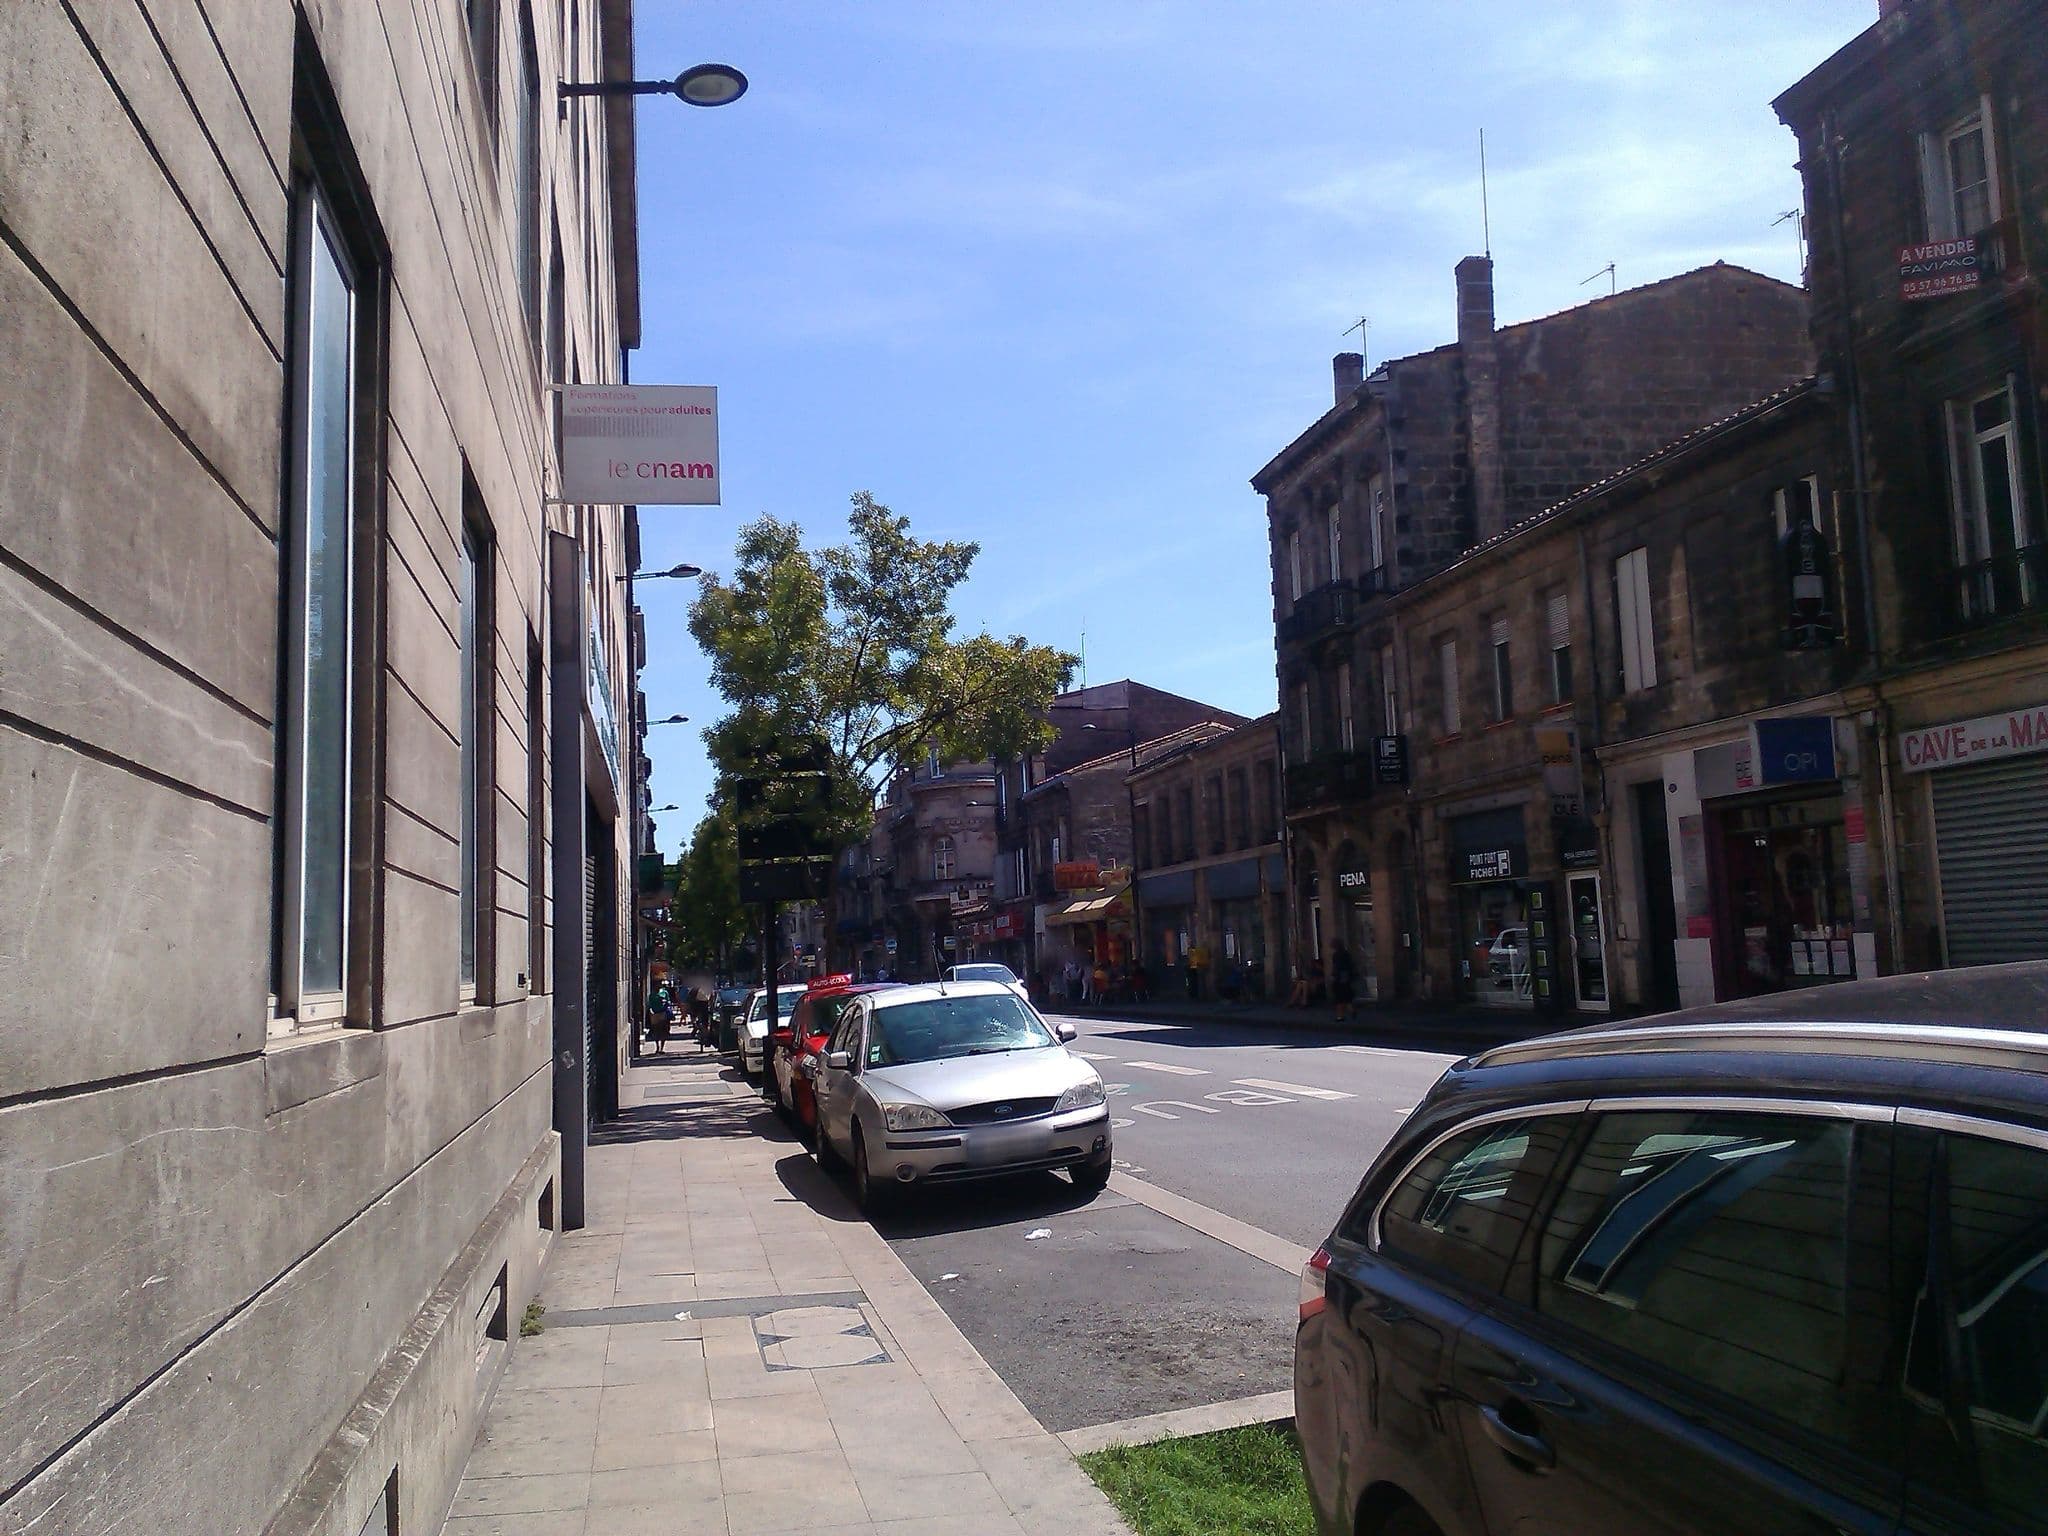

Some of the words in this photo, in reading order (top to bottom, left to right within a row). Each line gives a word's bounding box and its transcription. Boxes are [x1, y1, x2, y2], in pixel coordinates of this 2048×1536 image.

[1900, 249, 1912, 262] A
[1915, 240, 1976, 260] VENDRE
[1900, 255, 1977, 276] FAVIMO
[1918, 279, 1931, 290] 57
[669, 404, 712, 416] adultes
[608, 459, 629, 478] le
[636, 461, 714, 478] cnam
[1904, 726, 1968, 766] CAVE
[1971, 739, 1987, 751] DE
[1992, 735, 2008, 747] LA
[1340, 871, 1366, 887] PENA
